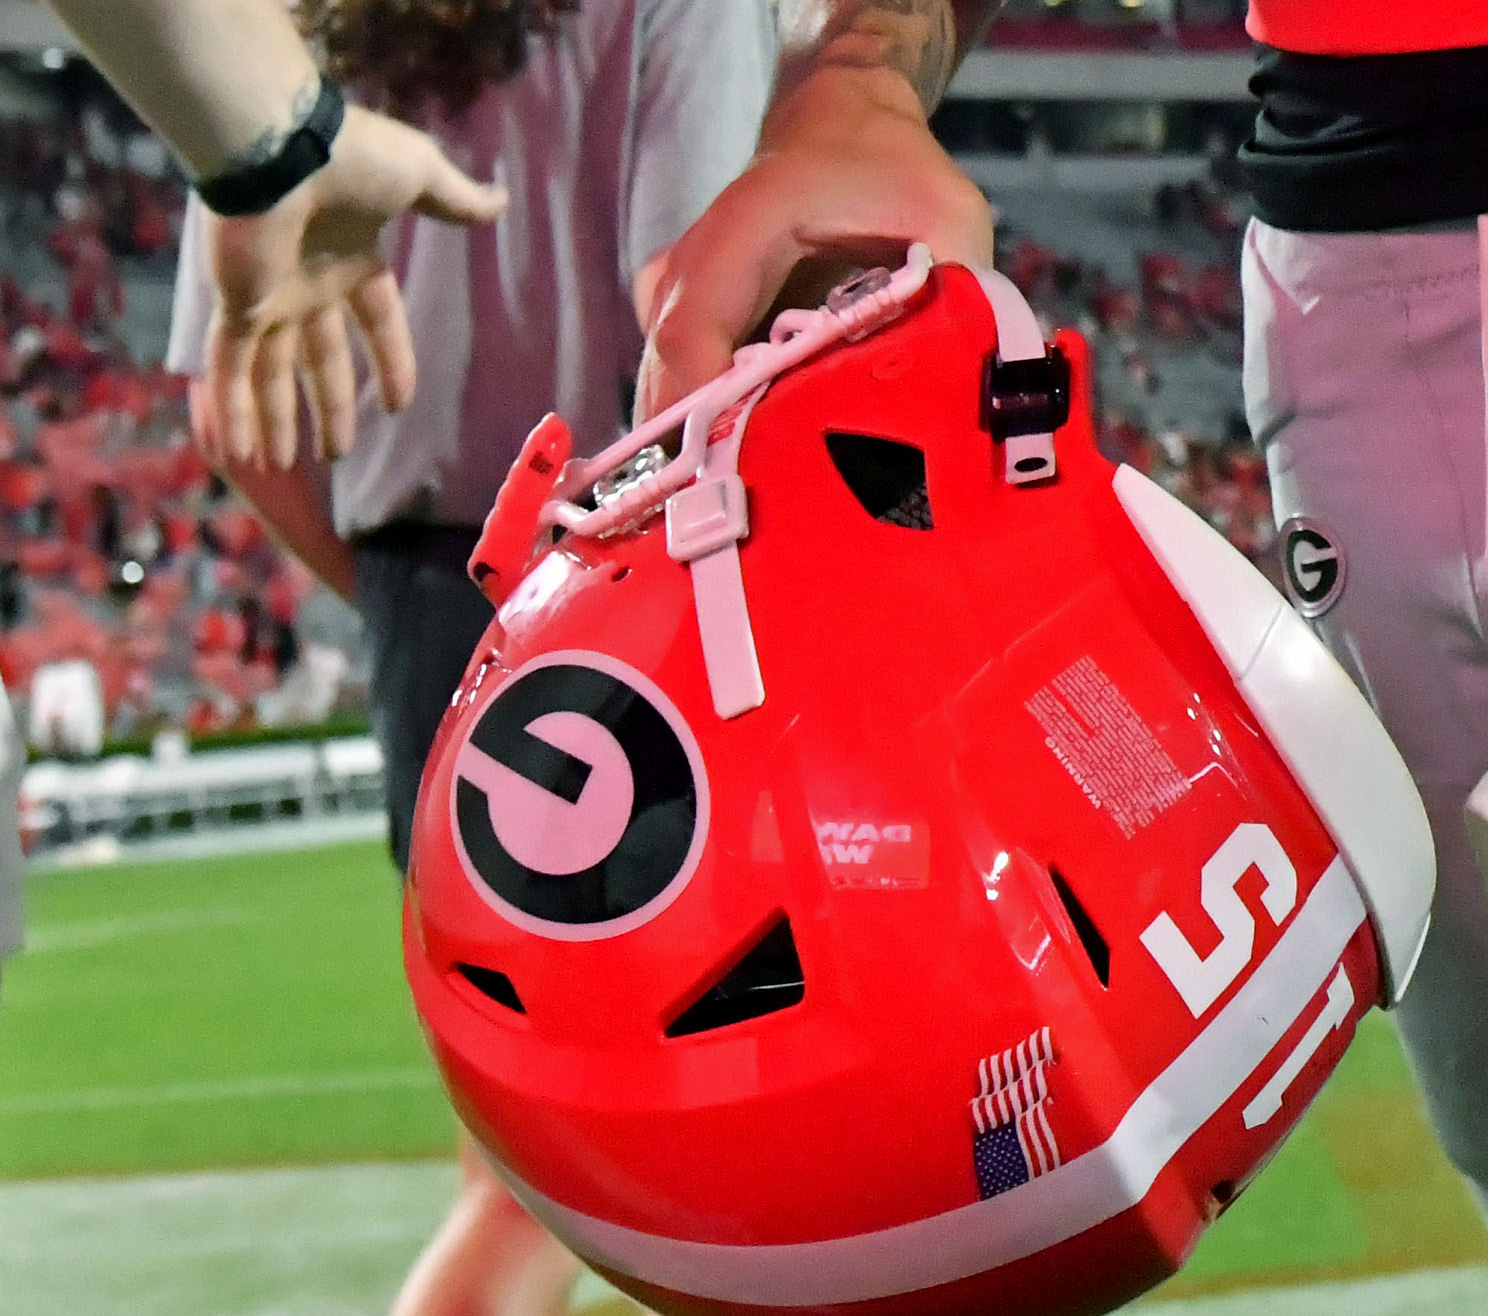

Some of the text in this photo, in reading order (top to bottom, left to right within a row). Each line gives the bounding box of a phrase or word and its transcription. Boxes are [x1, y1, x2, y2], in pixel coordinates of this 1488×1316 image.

[1287, 529, 1339, 603] G
[456, 663, 698, 925] G
[1045, 735, 1102, 809] WARNING
